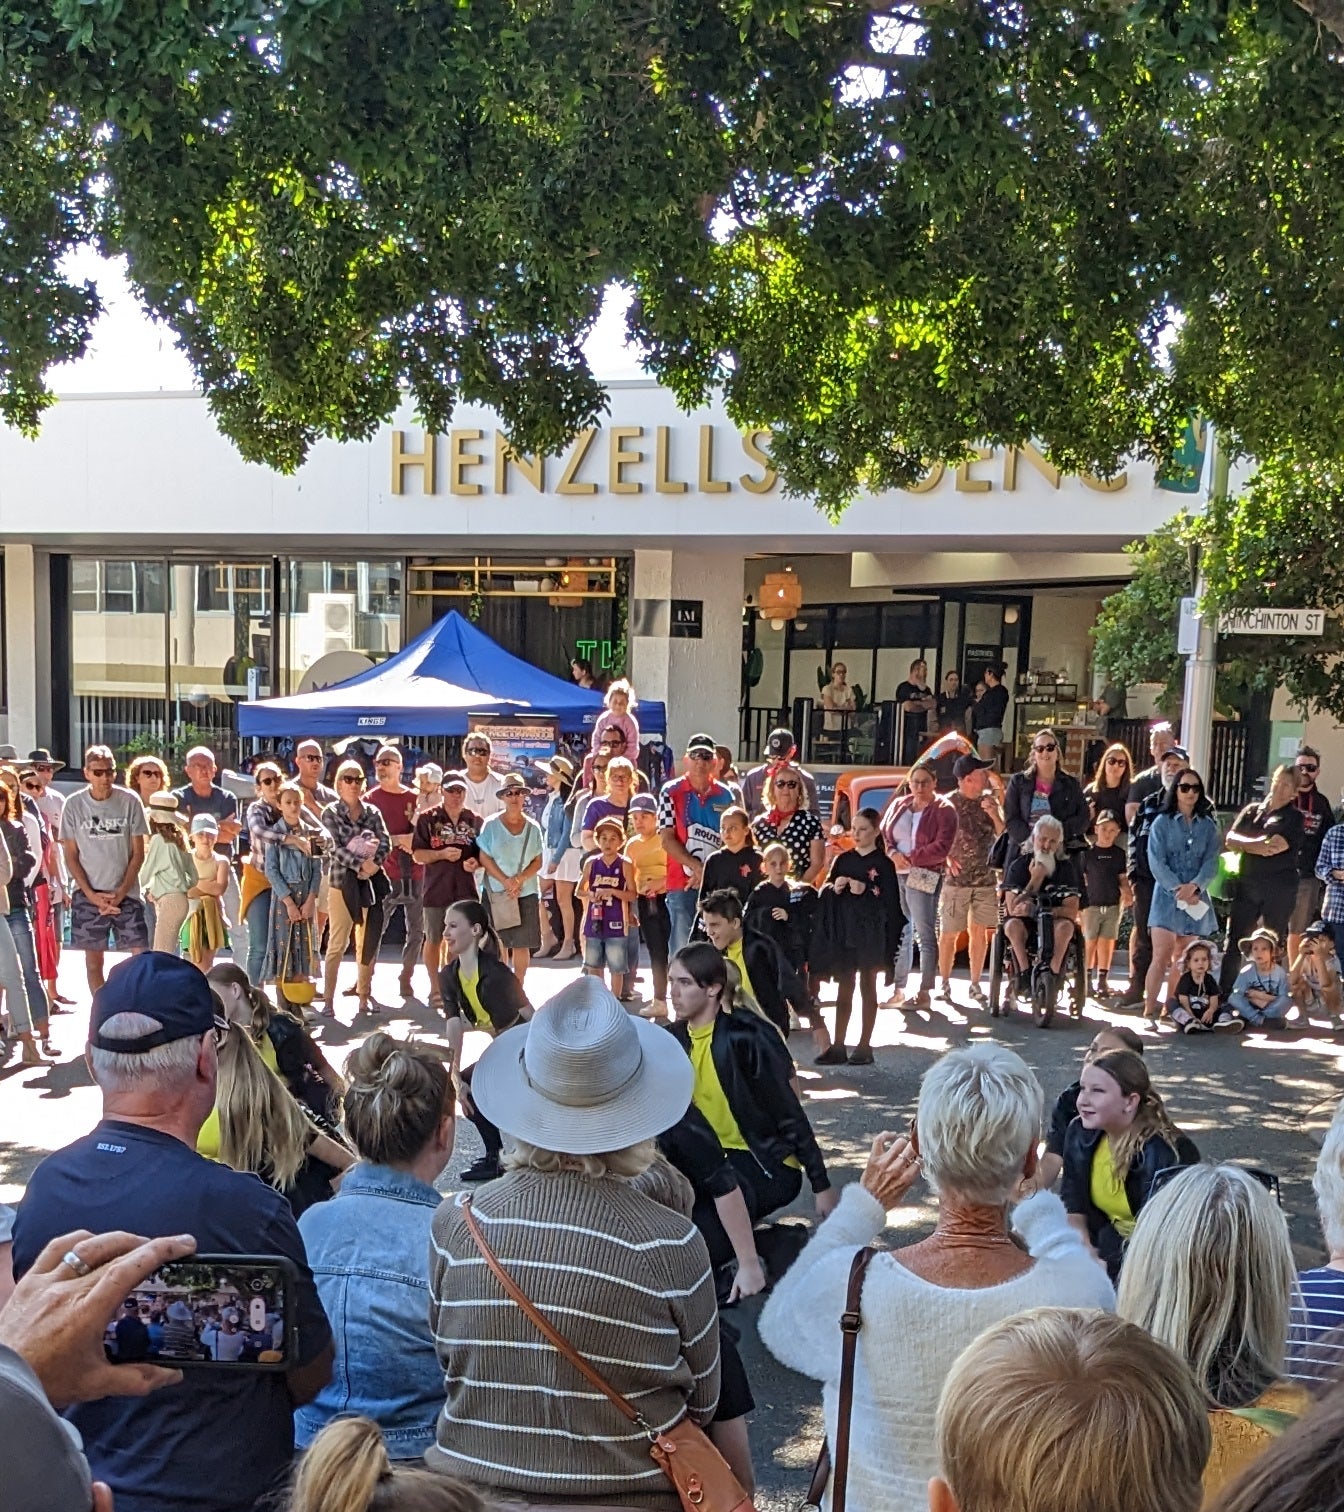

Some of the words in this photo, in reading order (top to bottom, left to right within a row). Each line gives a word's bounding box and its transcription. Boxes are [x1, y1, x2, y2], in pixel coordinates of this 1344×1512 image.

[391, 424, 778, 495] HENZELLS
[1305, 613, 1321, 631] ST
[80, 818, 128, 831] ALASKA
[694, 827, 722, 847] ROUTE
